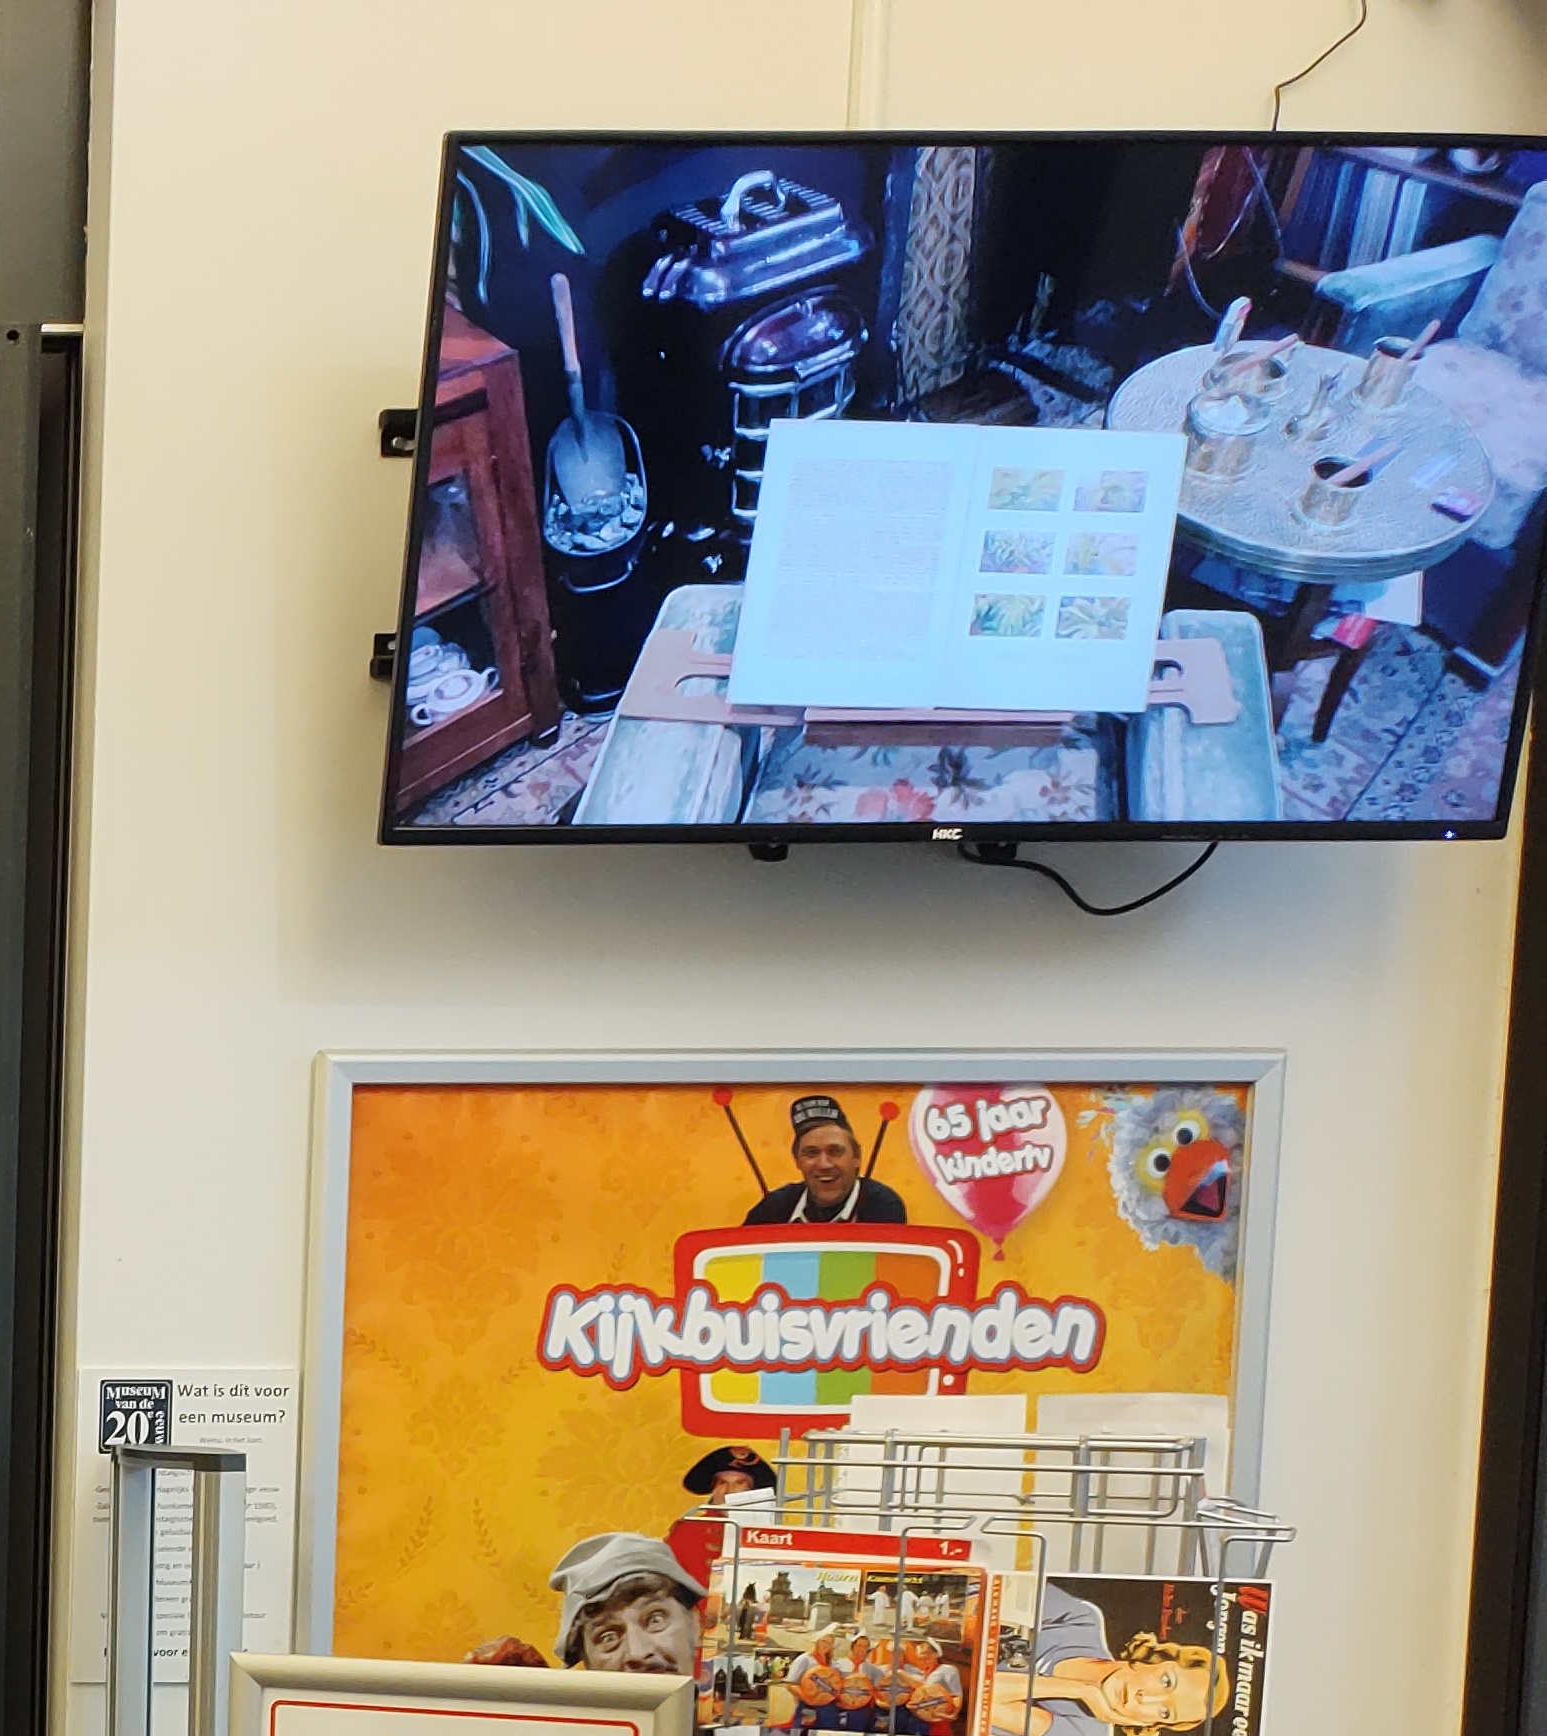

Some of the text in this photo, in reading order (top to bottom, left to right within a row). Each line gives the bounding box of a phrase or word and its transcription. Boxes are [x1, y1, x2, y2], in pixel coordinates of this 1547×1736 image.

[926, 1096, 1049, 1142] 65 jaar
[544, 1286, 1100, 1380] Kijkbuisvrienden
[177, 1383, 290, 1397] Wat is dit voor
[115, 1398, 155, 1409] van de
[178, 1410, 286, 1423] een museum?
[745, 1530, 794, 1546] Kaart
[1238, 1586, 1269, 1636] Was
[1239, 1638, 1264, 1661] ik
[1234, 1661, 1254, 1718] maar
